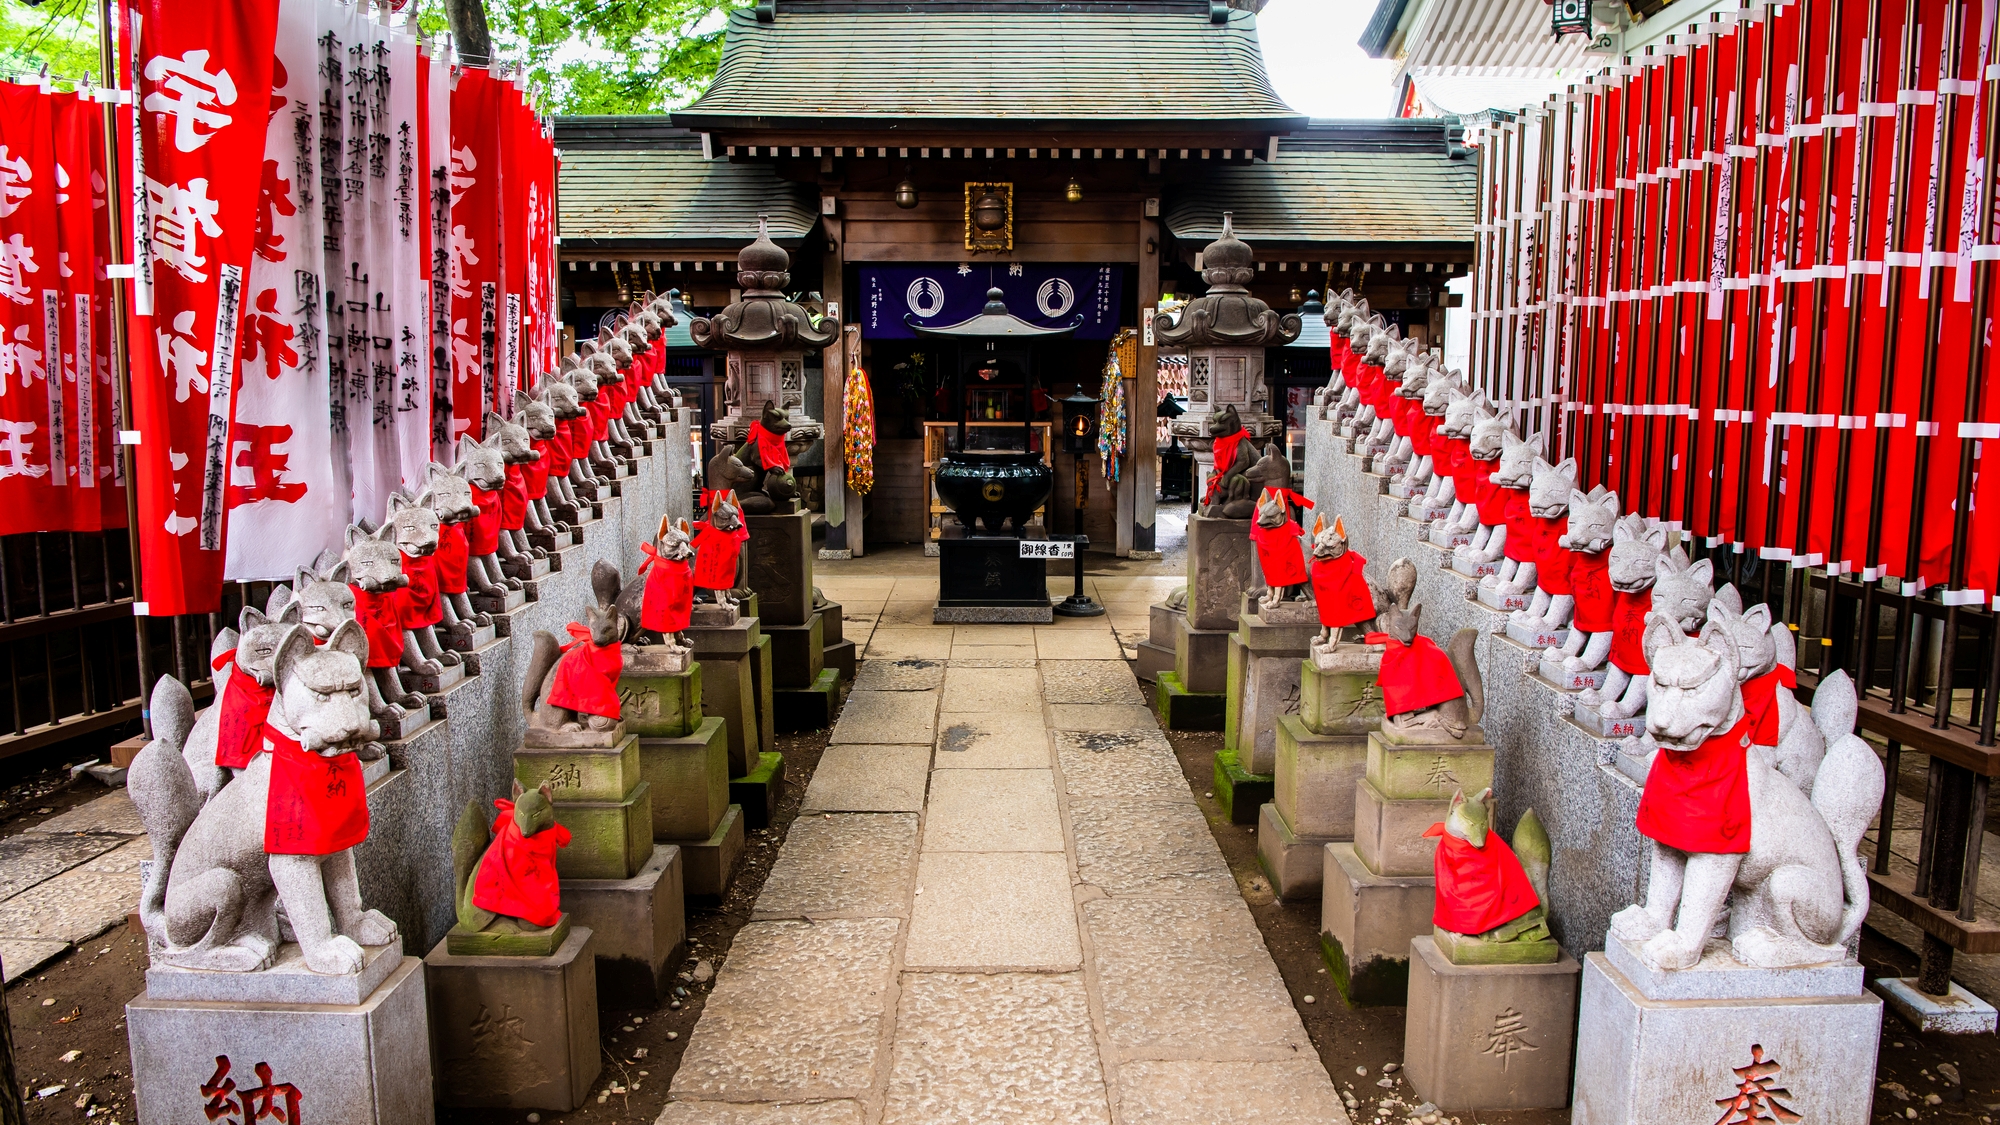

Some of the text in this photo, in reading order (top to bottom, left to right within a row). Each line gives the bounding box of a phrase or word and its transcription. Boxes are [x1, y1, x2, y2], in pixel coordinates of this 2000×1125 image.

[957, 263, 1023, 277] 奉 納
[1389, 466, 1404, 474] 奉納
[1409, 489, 1424, 497] 奉納
[1429, 511, 1446, 520] 奉納
[1452, 537, 1469, 546] 奉納
[1021, 543, 1060, 557] 御線香
[1476, 566, 1495, 575] 奉納
[1504, 598, 1523, 608] 奉納
[1621, 609, 1641, 646] 奉納
[1536, 635, 1557, 646] 奉納
[1572, 676, 1595, 687] 奉納
[1611, 723, 1635, 735] 奉納
[325, 762, 347, 799] 奉納
[549, 763, 582, 789] 納
[1423, 757, 1460, 791] 奉
[1482, 1007, 1540, 1073] 奉
[200, 1054, 303, 1125] 納
[1714, 1043, 1804, 1125] 奉
